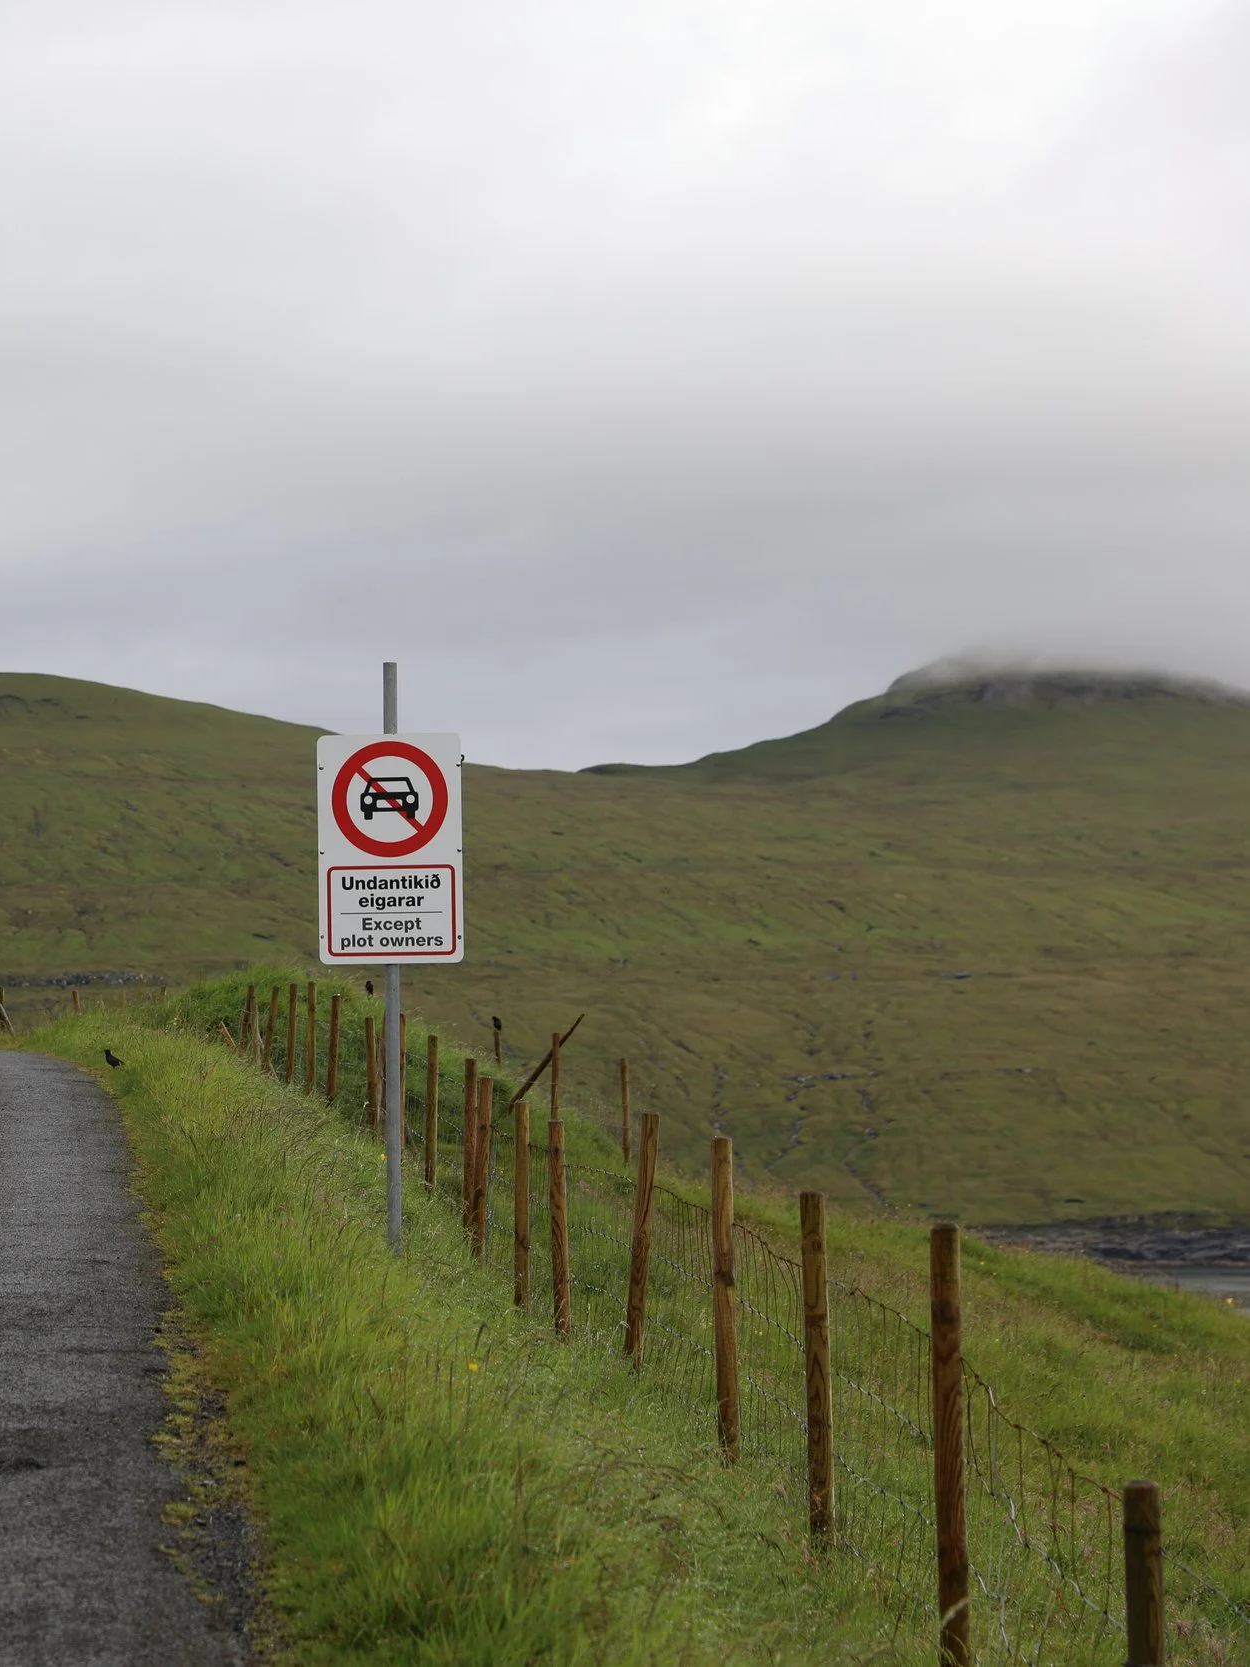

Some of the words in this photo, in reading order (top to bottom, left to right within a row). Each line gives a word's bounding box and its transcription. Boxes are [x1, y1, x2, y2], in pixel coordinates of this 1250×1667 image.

[341, 873, 441, 890] Undantikið
[358, 893, 425, 910] eigarar
[362, 917, 422, 933] Except
[340, 934, 374, 950] plot
[379, 935, 444, 948] owners
